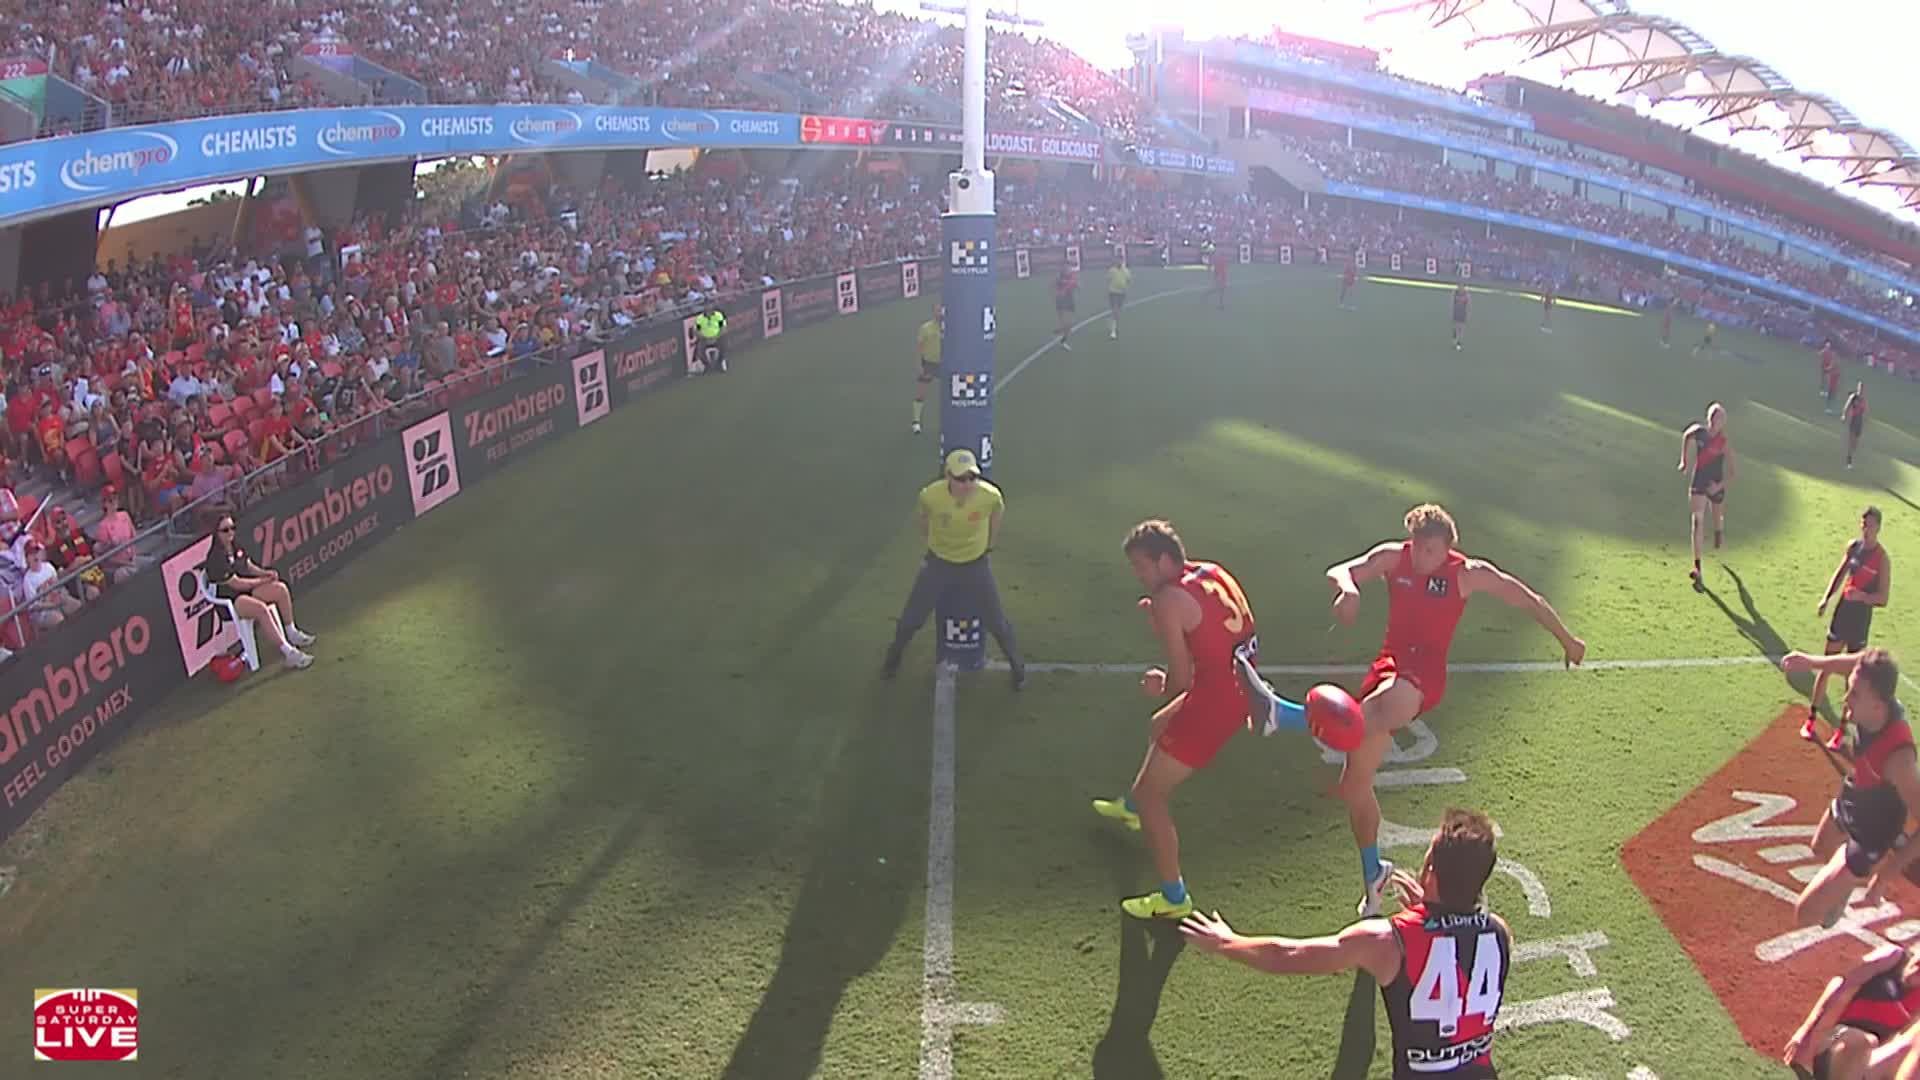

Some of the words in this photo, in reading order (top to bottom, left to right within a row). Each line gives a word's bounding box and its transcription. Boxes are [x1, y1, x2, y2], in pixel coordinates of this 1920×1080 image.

[4, 62, 27, 78] 222
[71, 146, 170, 177] chempro
[201, 125, 298, 158] CHEMISTS
[421, 117, 494, 138] CHEMISTS
[595, 115, 650, 132] CHEMISTS
[730, 119, 779, 135] CHEMISTS
[985, 133, 1038, 154] LDCOAST.
[1041, 139, 1100, 159] GOLDCOAST.
[464, 384, 566, 448] Zambrero
[253, 464, 393, 567] Zambrero
[288, 553, 318, 584] FEEL
[318, 528, 353, 563] GOOD
[0, 615, 150, 764] ambrero
[3, 761, 46, 807] FEEL
[46, 714, 96, 767] GOOD
[96, 684, 133, 726] MEX
[1409, 932, 1502, 1038] 44
